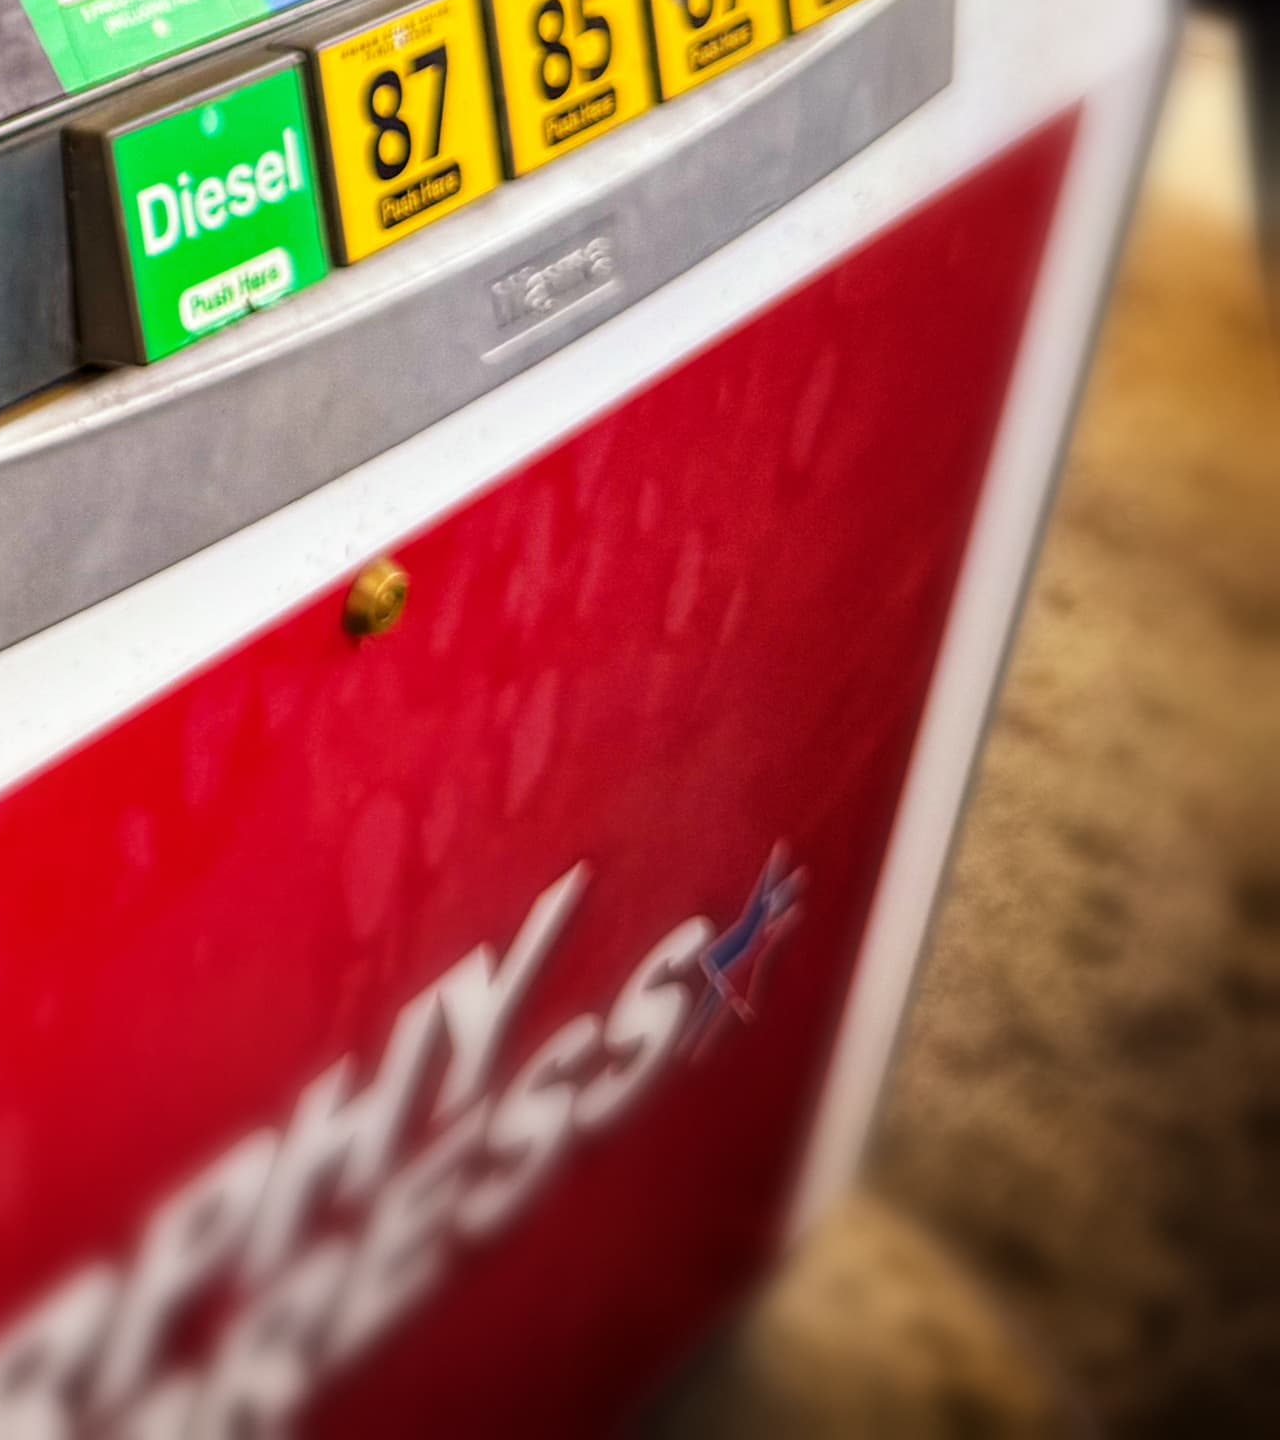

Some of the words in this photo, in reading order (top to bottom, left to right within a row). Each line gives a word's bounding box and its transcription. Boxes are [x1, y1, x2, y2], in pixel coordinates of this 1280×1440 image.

[369, 40, 448, 181] 87
[137, 127, 303, 256] Diesel
[382, 189, 419, 222] Push
[420, 171, 458, 204] Here
[191, 283, 234, 318] Push
[238, 265, 279, 294] Here
